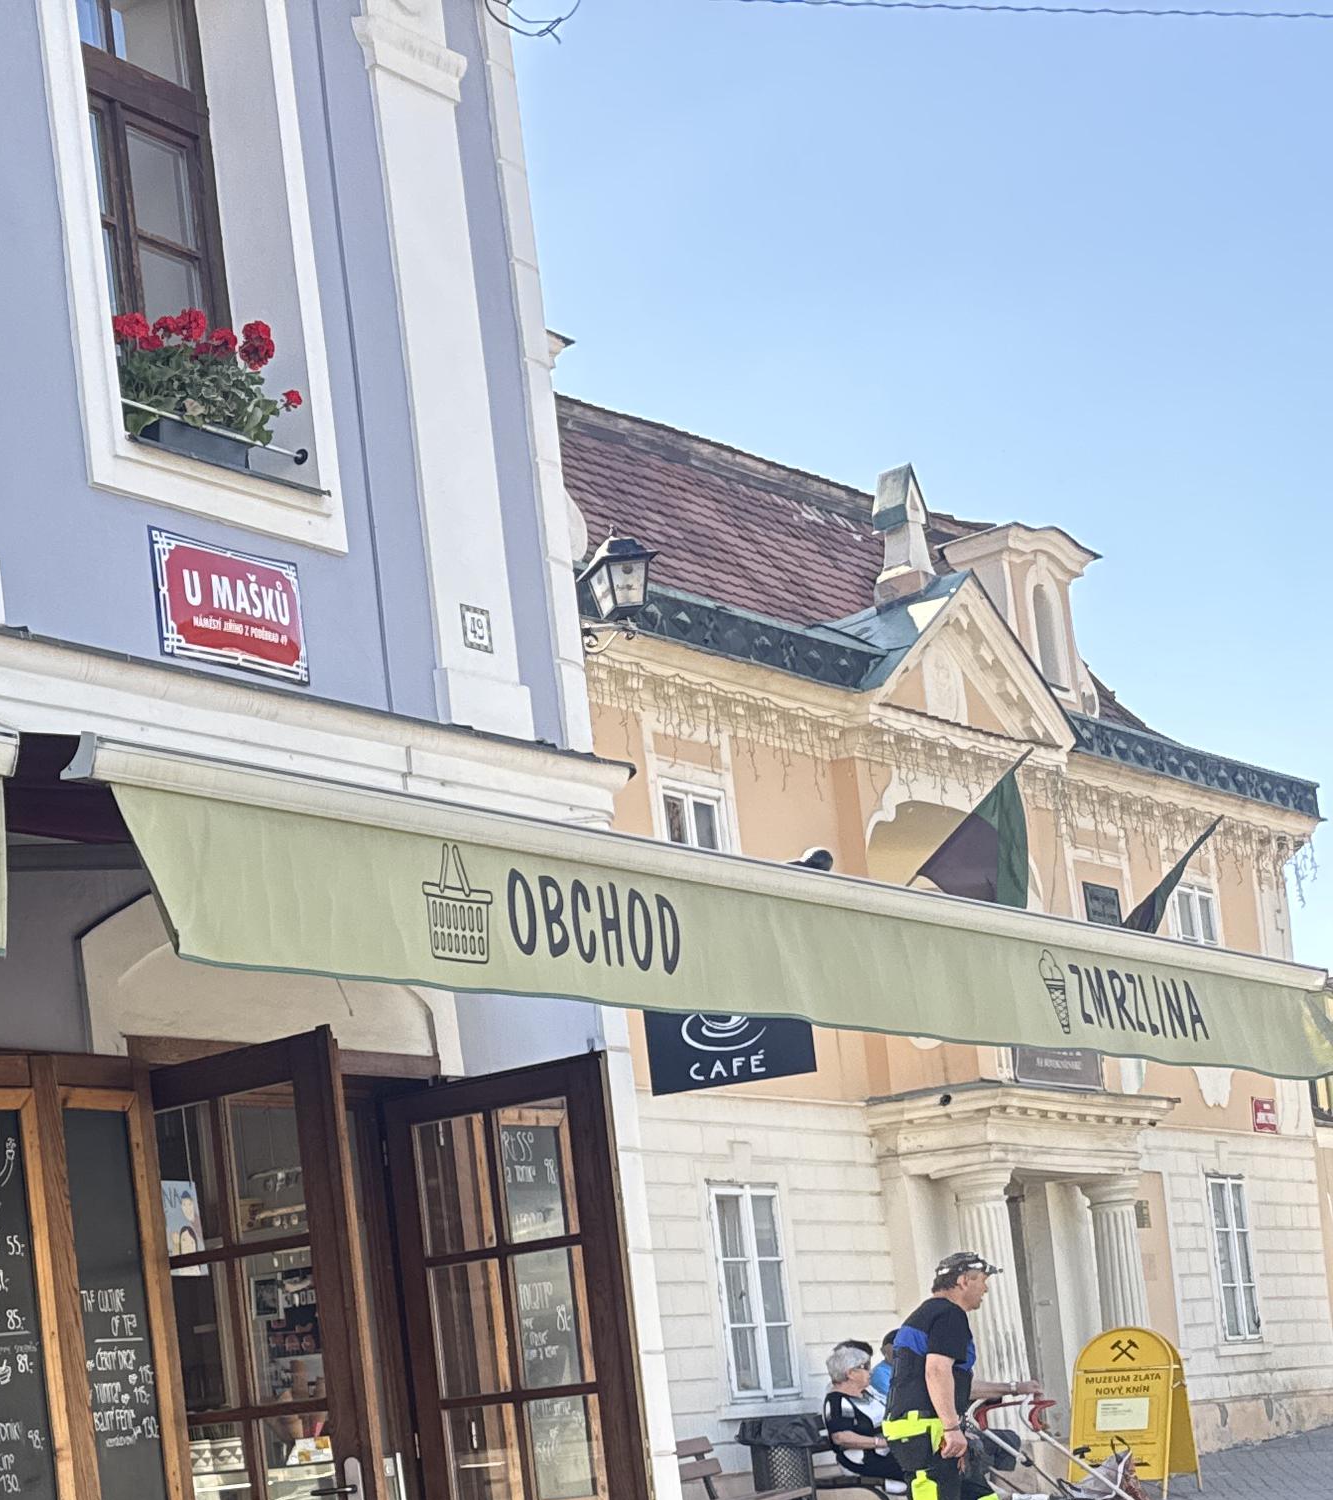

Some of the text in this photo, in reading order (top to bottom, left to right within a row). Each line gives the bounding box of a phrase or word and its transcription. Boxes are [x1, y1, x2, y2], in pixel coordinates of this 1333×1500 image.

[182, 568, 290, 626] U MAŠKŮ
[193, 613, 222, 631] NÁMĚSTÍ
[244, 625, 250, 637] Z
[250, 626, 279, 644] PODĚBRAD
[470, 616, 485, 641] 49
[507, 866, 680, 976] OBCHOD
[1068, 963, 1210, 1042] ZMRZLINA
[689, 1049, 766, 1081] CAFÉ
[1085, 1372, 1162, 1385] MUZEUM ZLATA
[1095, 1384, 1150, 1396] NOVÝ KNÍN
